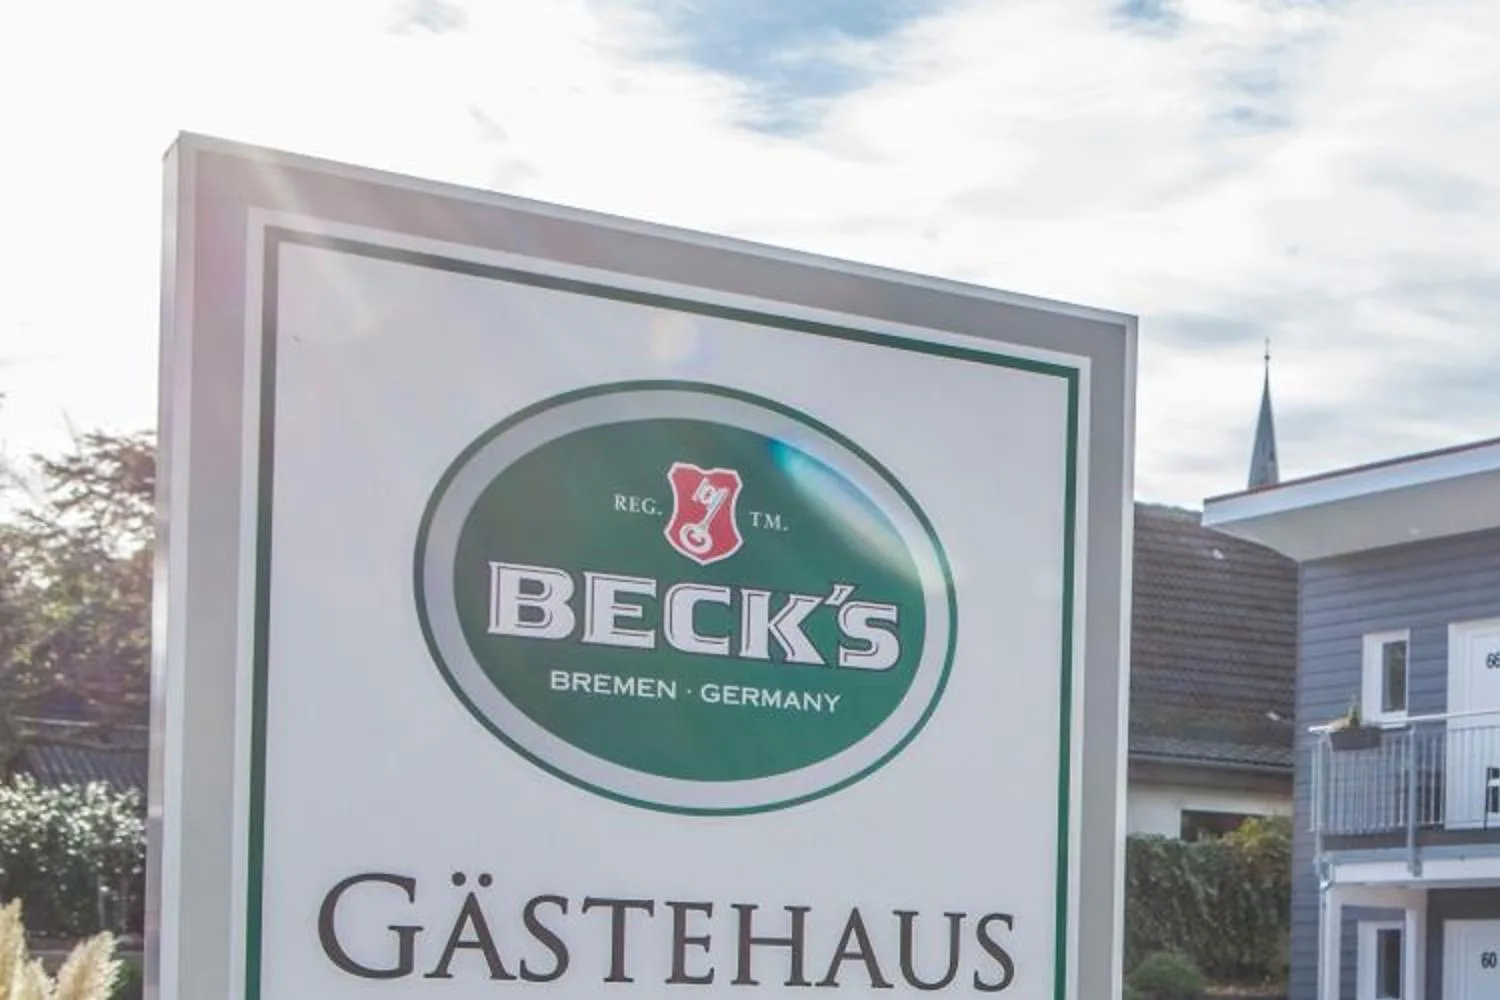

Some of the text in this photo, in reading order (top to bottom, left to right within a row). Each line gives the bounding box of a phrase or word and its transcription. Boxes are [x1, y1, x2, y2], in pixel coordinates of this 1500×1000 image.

[613, 493, 790, 532] REG. TM.
[487, 560, 902, 672] BECK'S
[550, 669, 841, 713] BREMEN GERMANY
[317, 871, 1016, 992] GÄSTEHAUS
[1481, 951, 1498, 969] 60
